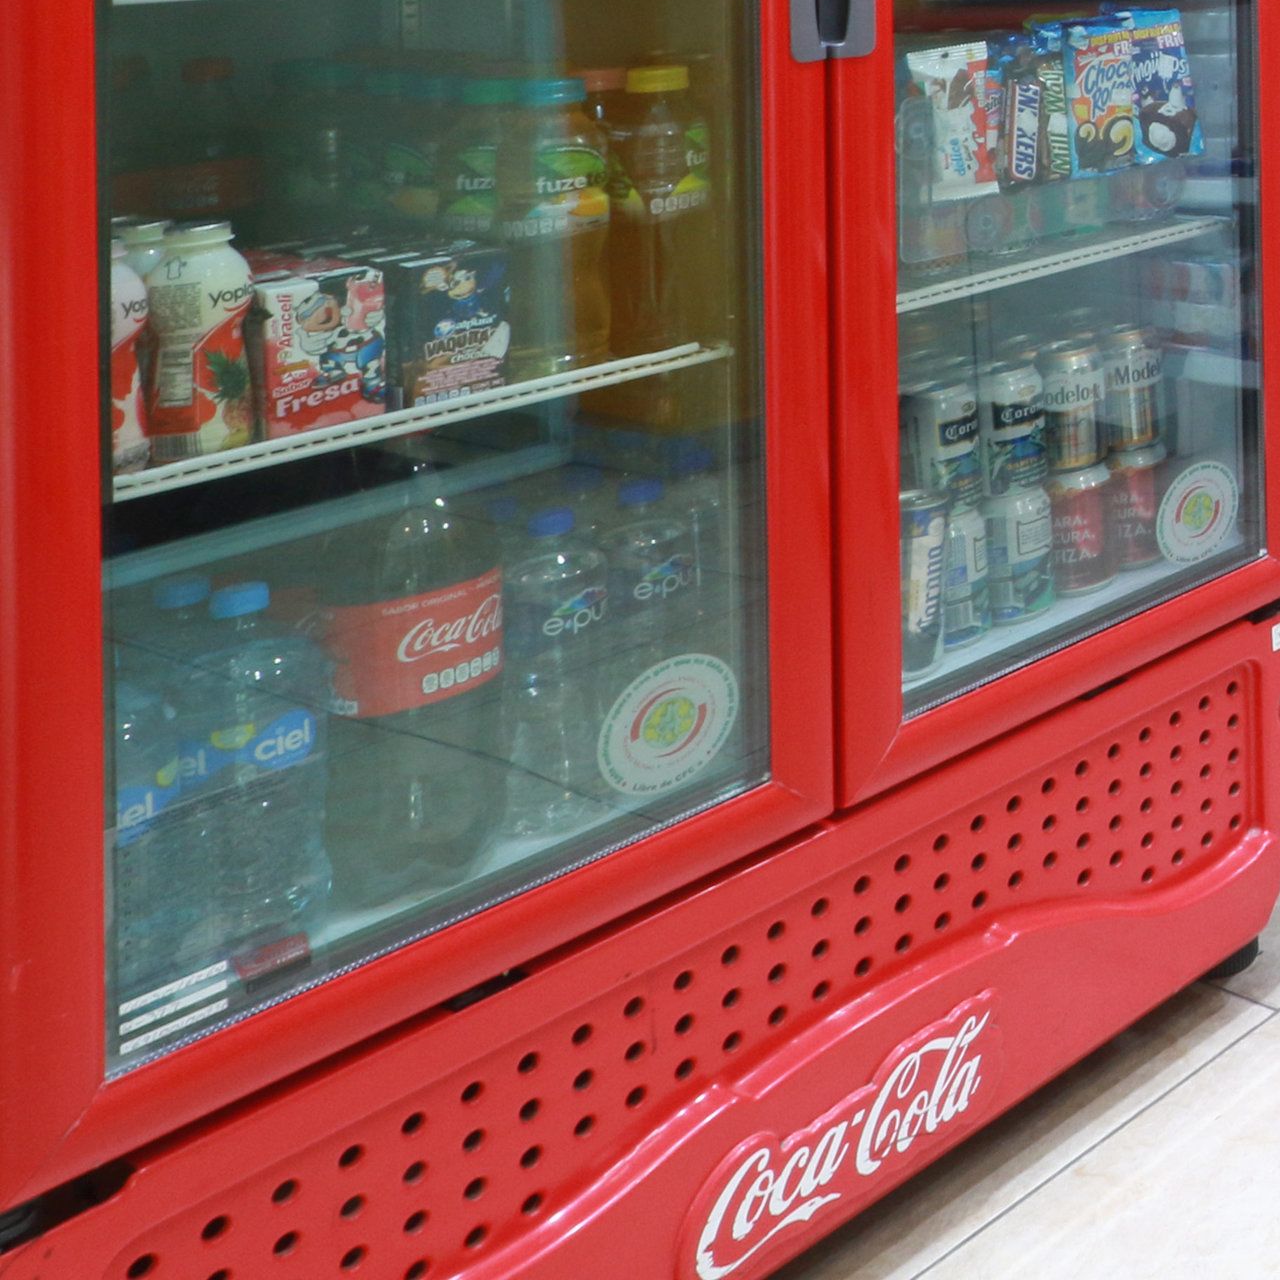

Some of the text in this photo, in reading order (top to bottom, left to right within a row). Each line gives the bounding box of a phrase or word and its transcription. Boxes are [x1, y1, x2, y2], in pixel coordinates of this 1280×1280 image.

[1083, 59, 1133, 93] Choc
[686, 149, 708, 168] fu
[455, 171, 496, 193] fuz
[536, 172, 587, 193] fuze
[208, 281, 255, 309] yopla
[279, 293, 293, 349] Araceli
[424, 327, 495, 360] VAQUITA
[1114, 352, 1161, 387] Model
[272, 379, 313, 400] Sabor
[276, 374, 360, 418] Fresa
[1044, 384, 1091, 405] odelo
[1001, 401, 1044, 424] Coron
[945, 419, 978, 441] Coro
[382, 588, 472, 616] SABOR ORIGINAL
[397, 593, 502, 663] Coca-Col
[254, 720, 310, 762] ciel
[632, 765, 696, 792] Libre de CFC
[116, 793, 154, 831] iel
[696, 1010, 991, 1280] Coca-Cola
